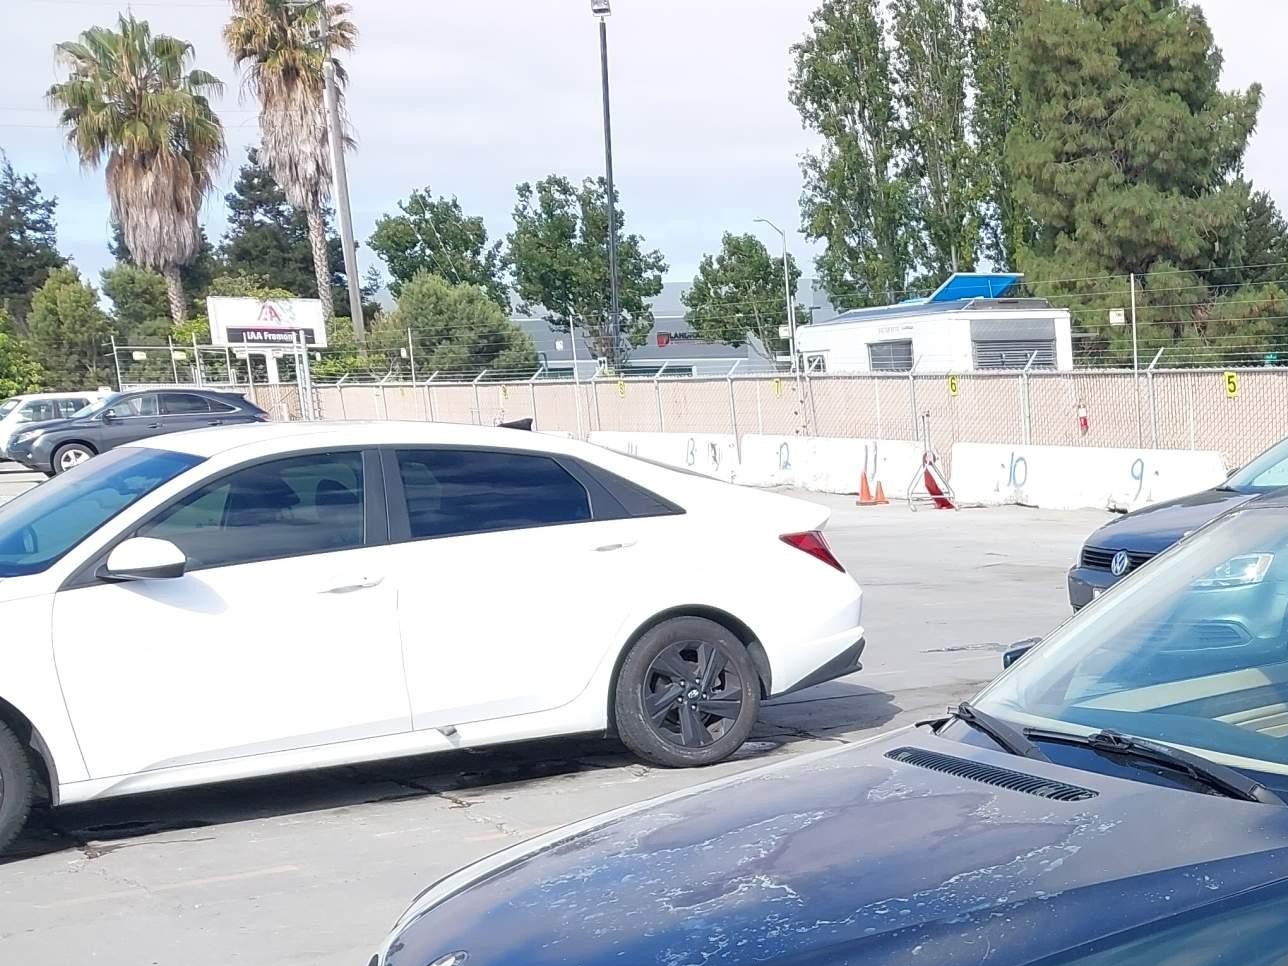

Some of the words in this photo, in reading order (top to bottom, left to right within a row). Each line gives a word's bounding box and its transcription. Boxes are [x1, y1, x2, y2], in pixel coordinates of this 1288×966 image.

[247, 331, 263, 340] IAA
[264, 331, 298, 340] Fremon
[951, 376, 957, 393] 6
[1227, 375, 1236, 393] 5
[1007, 452, 1028, 488] 10
[1130, 458, 1144, 501] 9
